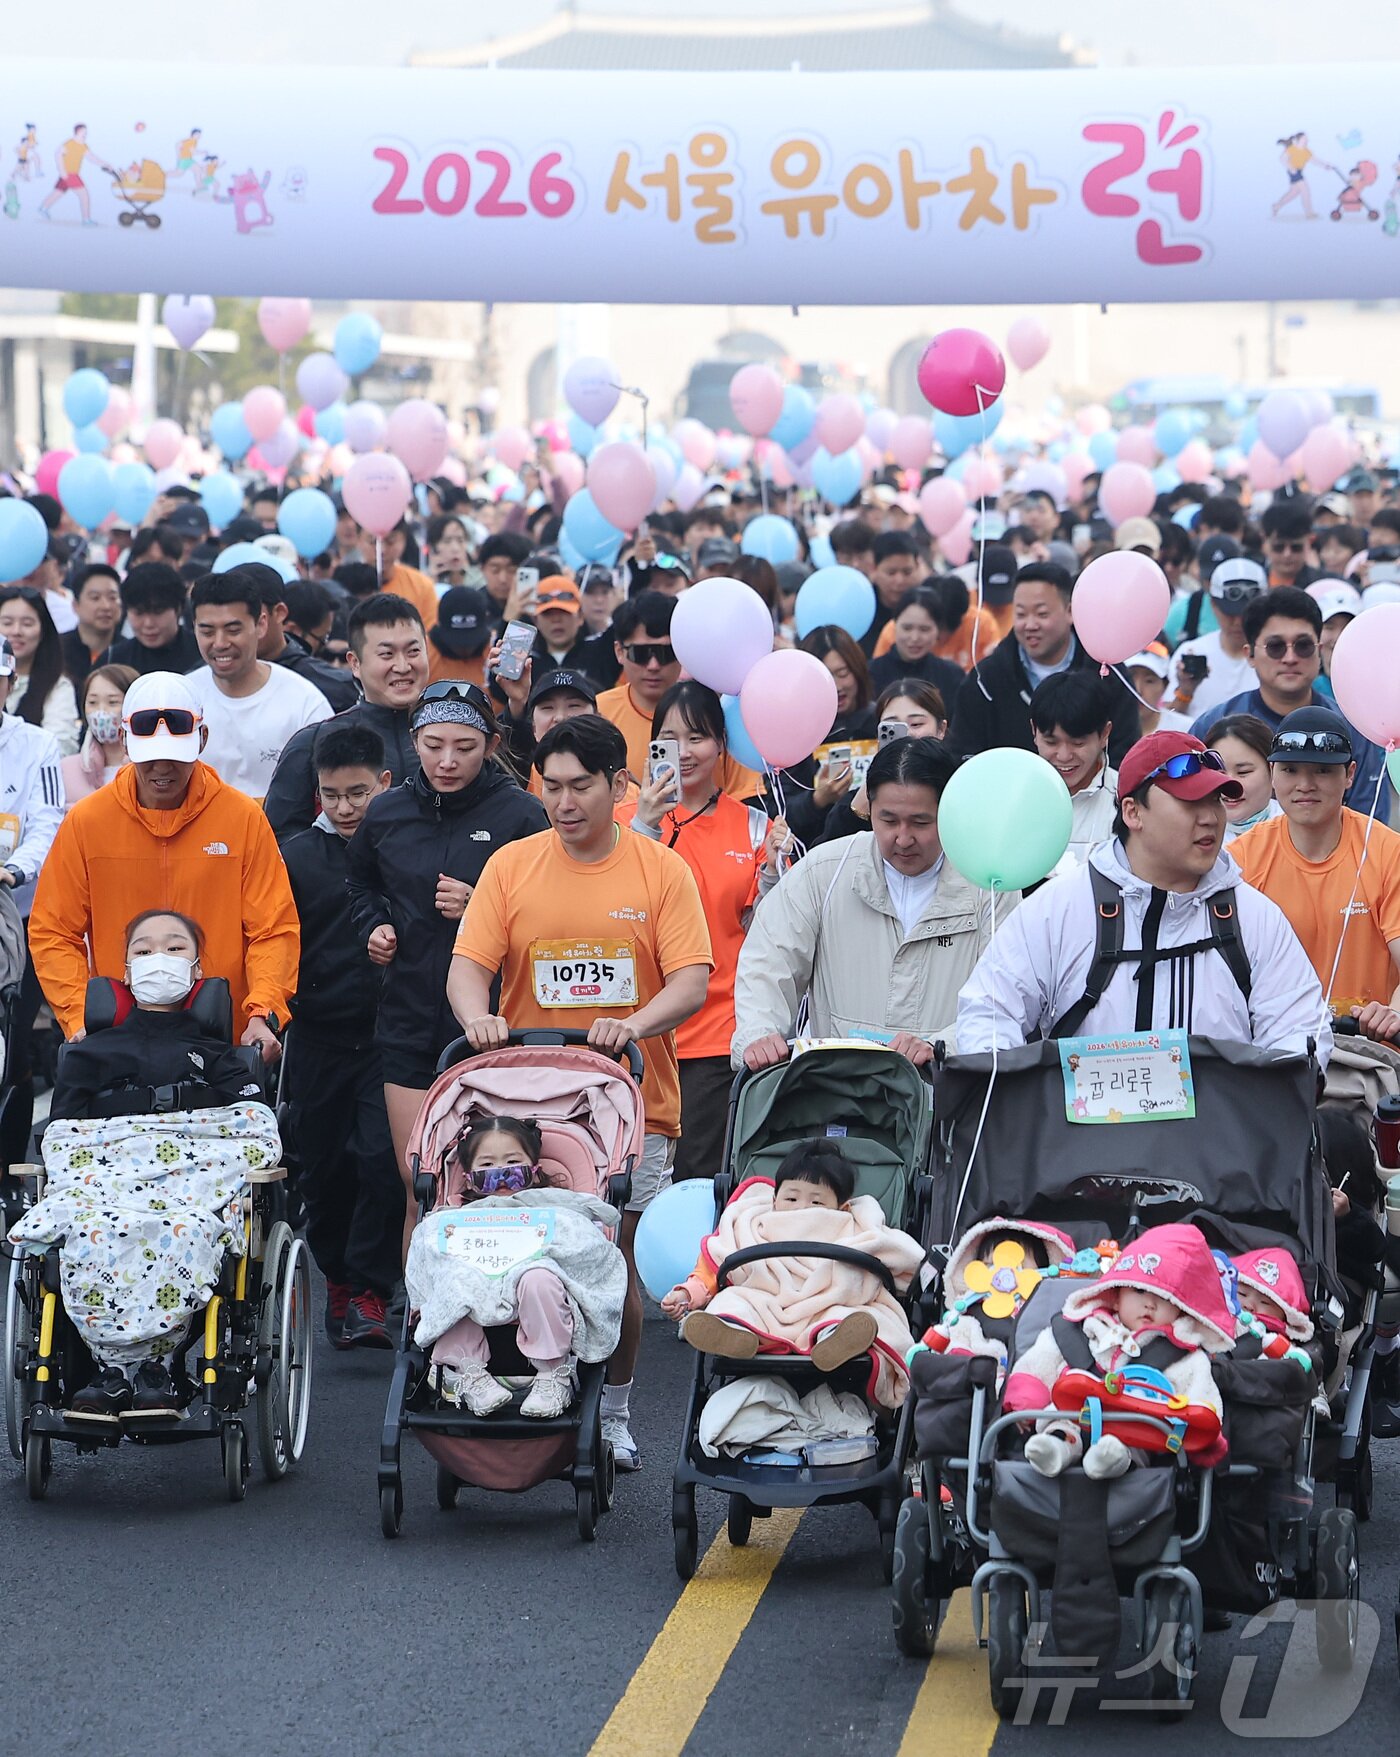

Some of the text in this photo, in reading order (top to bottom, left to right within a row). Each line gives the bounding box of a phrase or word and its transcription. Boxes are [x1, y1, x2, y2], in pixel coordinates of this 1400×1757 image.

[373, 110, 1203, 266] 2026 서울 유아차 런
[938, 937, 953, 947] NFL
[553, 962, 615, 983] 10735
[1148, 1035, 1160, 1049] 런
